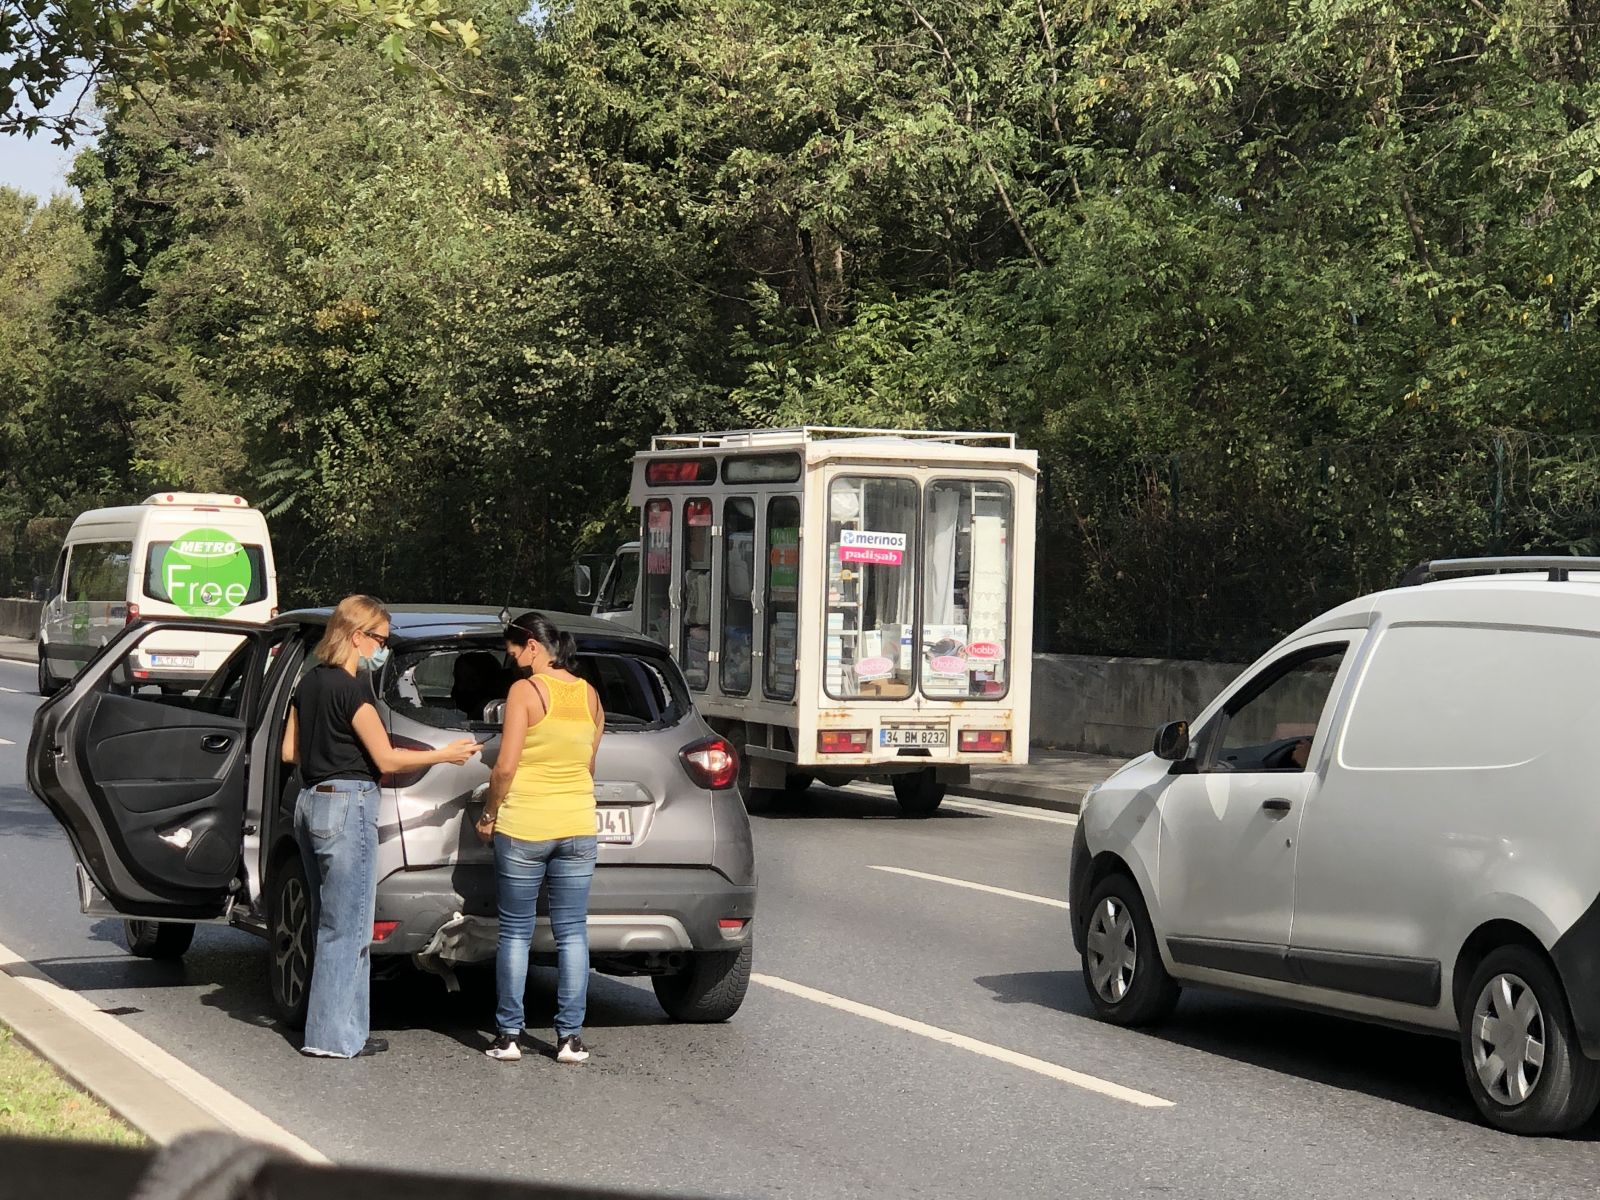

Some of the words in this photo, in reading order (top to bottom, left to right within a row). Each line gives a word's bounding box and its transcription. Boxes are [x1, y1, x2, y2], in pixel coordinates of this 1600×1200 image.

[856, 534, 903, 547] merinos
[179, 541, 237, 554] METRO
[167, 564, 247, 607] Free
[971, 645, 998, 657] hobby
[886, 731, 899, 744] 34
[904, 731, 918, 744] BM
[921, 731, 946, 744] 8232
